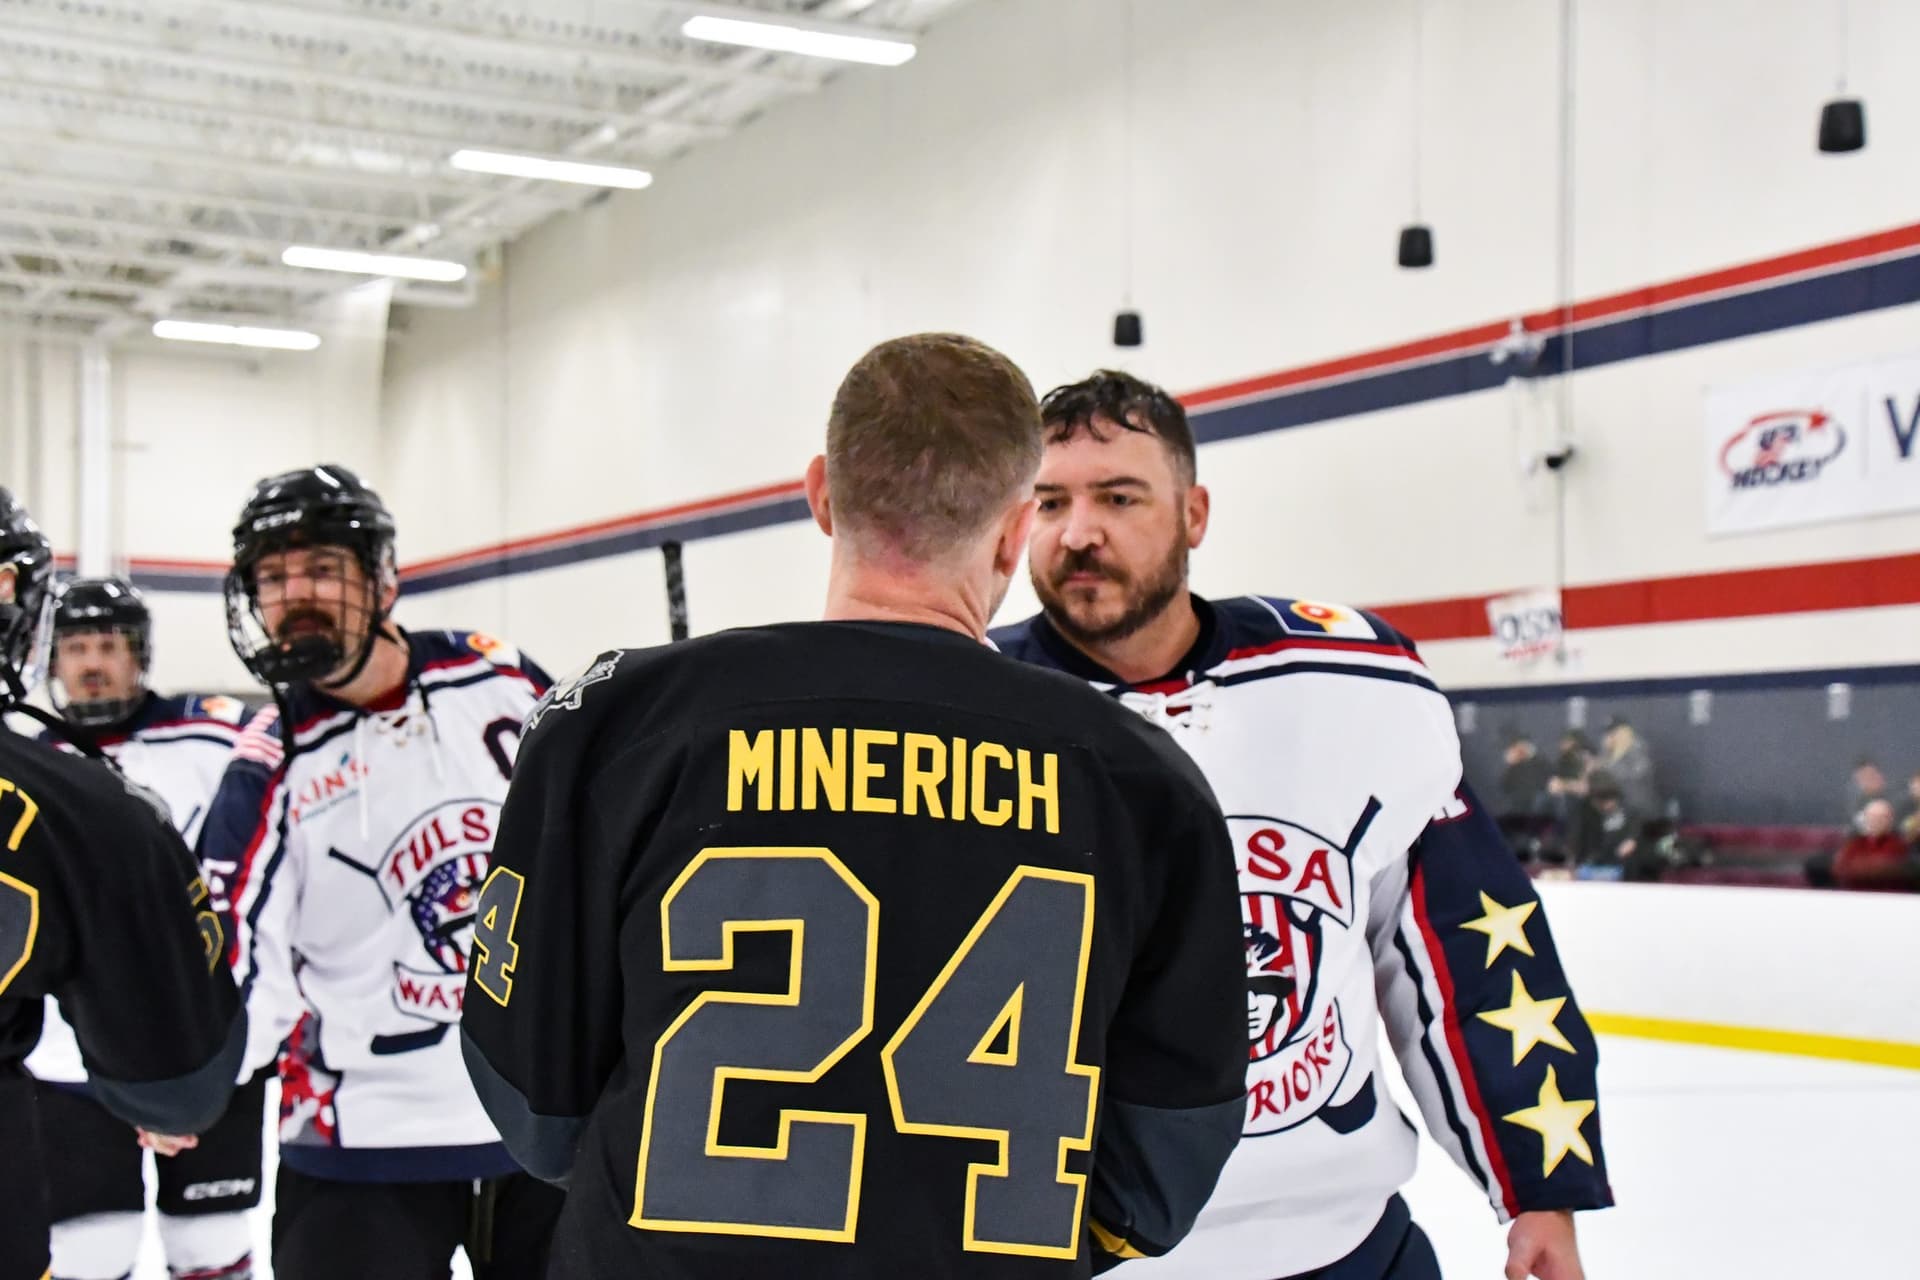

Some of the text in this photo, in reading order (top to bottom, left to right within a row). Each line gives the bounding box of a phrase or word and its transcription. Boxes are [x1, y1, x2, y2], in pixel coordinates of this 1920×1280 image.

[1884, 390, 1920, 459] V
[727, 727, 1060, 834] MINERICH
[388, 807, 491, 888] TULS
[1246, 828, 1343, 909] SA
[473, 866, 525, 1007] 4
[628, 847, 1100, 1261] 24
[1247, 1003, 1336, 1122] RIORS
[183, 1178, 255, 1201] CCM
